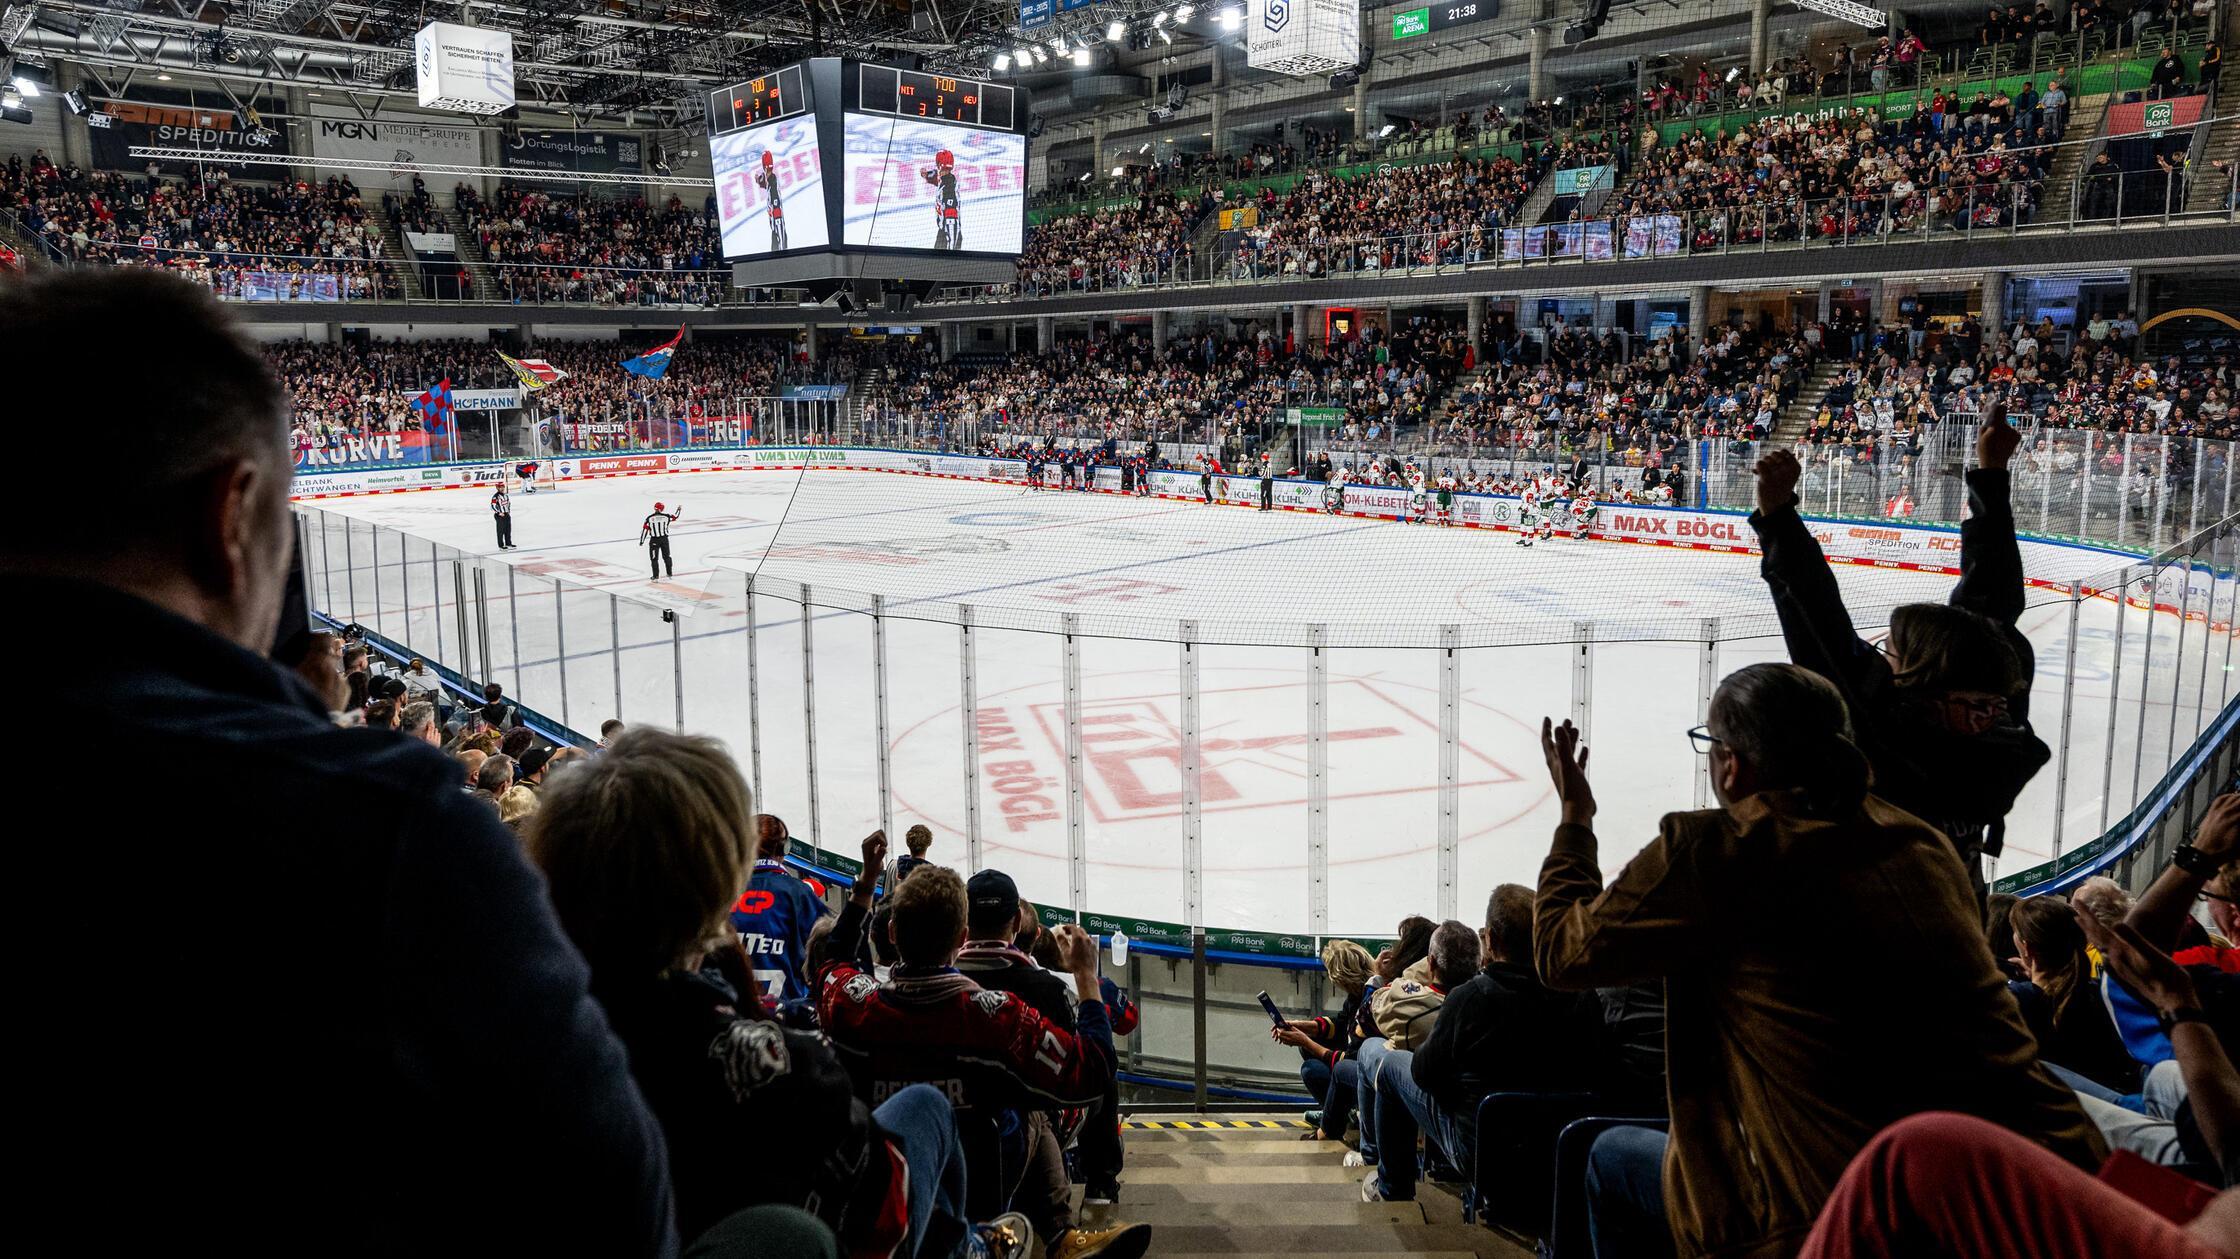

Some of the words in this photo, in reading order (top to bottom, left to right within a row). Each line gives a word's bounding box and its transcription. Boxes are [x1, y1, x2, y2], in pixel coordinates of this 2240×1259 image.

[1448, 4, 1477, 20] 21:38
[1406, 16, 1419, 24] Bank
[1402, 24, 1424, 34] ARENA
[441, 45, 475, 54] VERTRAUEN
[475, 50, 505, 58] SCHAFFEN
[447, 51, 480, 60] SICHERHEIT
[754, 98, 760, 109] 3
[937, 95, 943, 106] 3
[919, 102, 927, 116] 3
[1886, 103, 1912, 113] SPORT
[745, 111, 752, 125] 3
[1757, 106, 1865, 128] #EnfchLive
[2145, 118, 2170, 127] Bank
[321, 121, 378, 141] MGN
[527, 138, 607, 155] OrtungsLogistik
[508, 157, 535, 166] Flotten
[454, 397, 514, 409] HOFMANN
[1273, 494, 1304, 504] KÜHL
[1614, 514, 1668, 535] MAX
[1676, 516, 1742, 541] BÖGL
[1868, 538, 1920, 550] SPEDITION
[974, 707, 1025, 754] MAX
[984, 760, 1062, 833] BÖGL
[1058, 914, 1076, 924] Bank
[1103, 921, 1121, 931] Bank
[1149, 927, 1168, 936] Bank
[1245, 936, 1265, 947] Bank
[1295, 941, 1314, 951] Bank
[1034, 1030, 1068, 1075] 17
